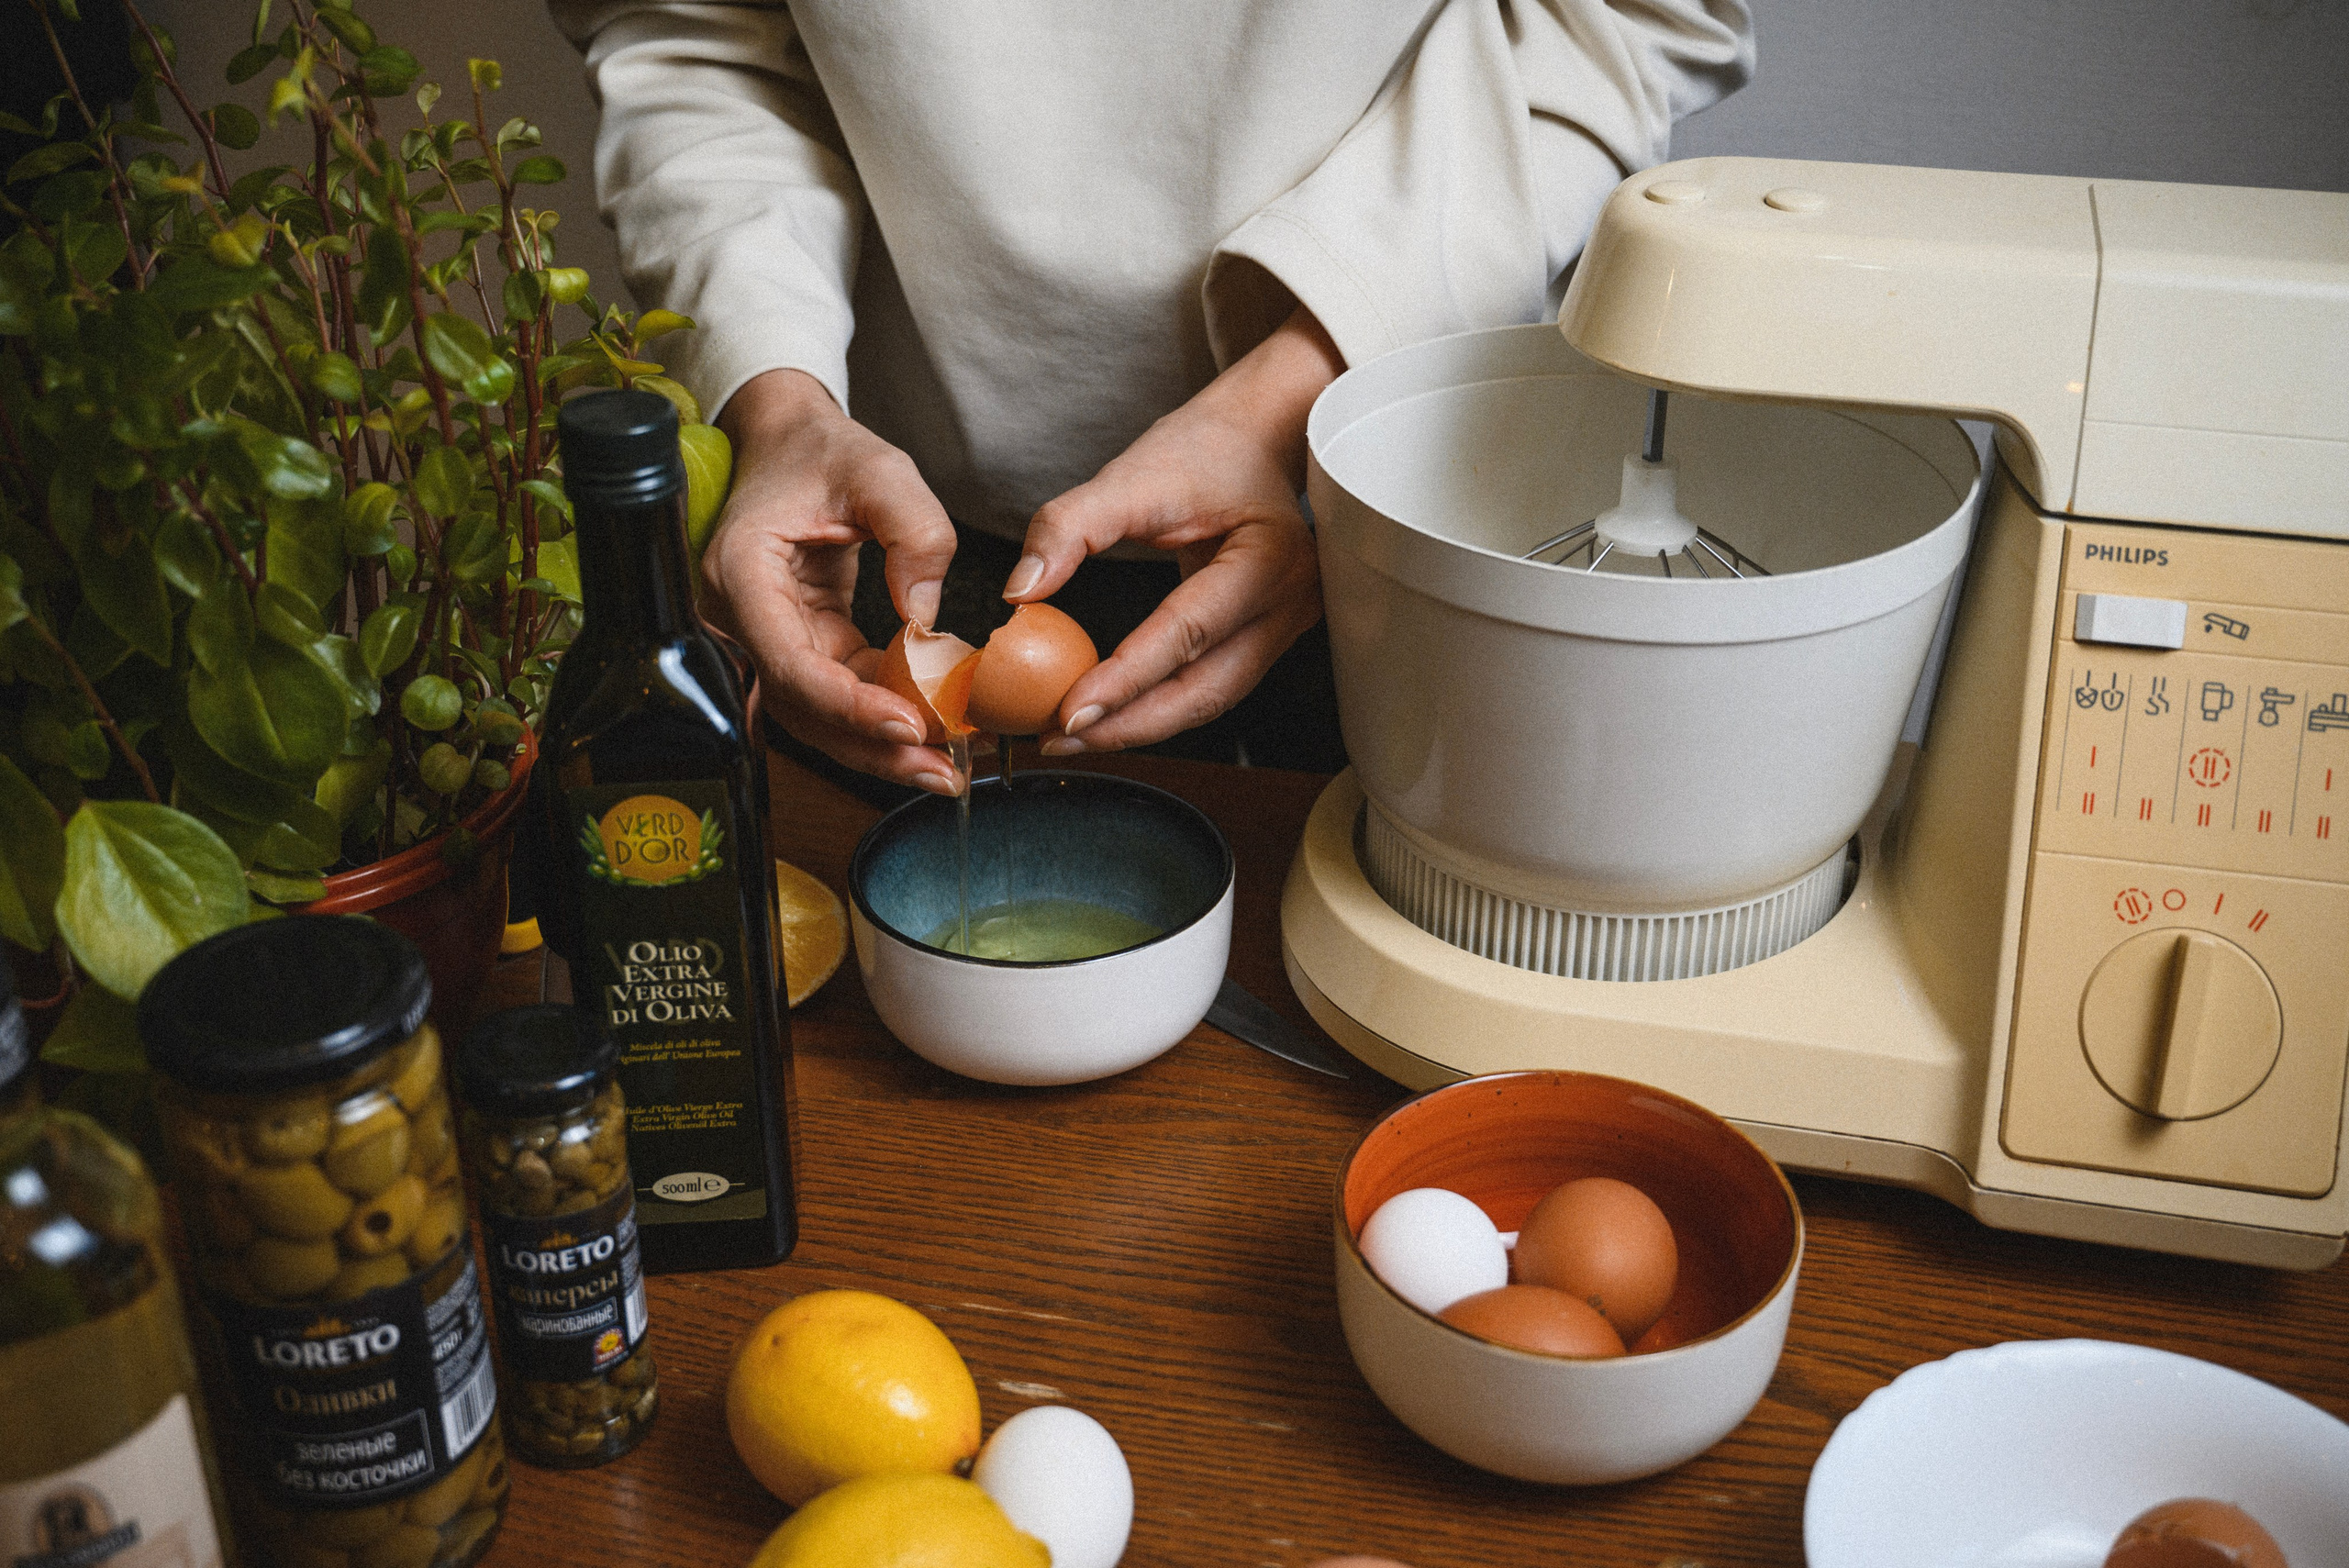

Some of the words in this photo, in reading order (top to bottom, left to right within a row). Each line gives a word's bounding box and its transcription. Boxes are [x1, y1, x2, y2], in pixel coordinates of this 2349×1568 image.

[2085, 543, 2169, 566] PHILIPS
[616, 811, 685, 838] VERD
[615, 838, 691, 865] D'OR
[502, 1234, 615, 1274] LORETO
[253, 1323, 402, 1369] LORETO
[275, 1379, 397, 1417] Оливки
[319, 1449, 428, 1493] косточки
